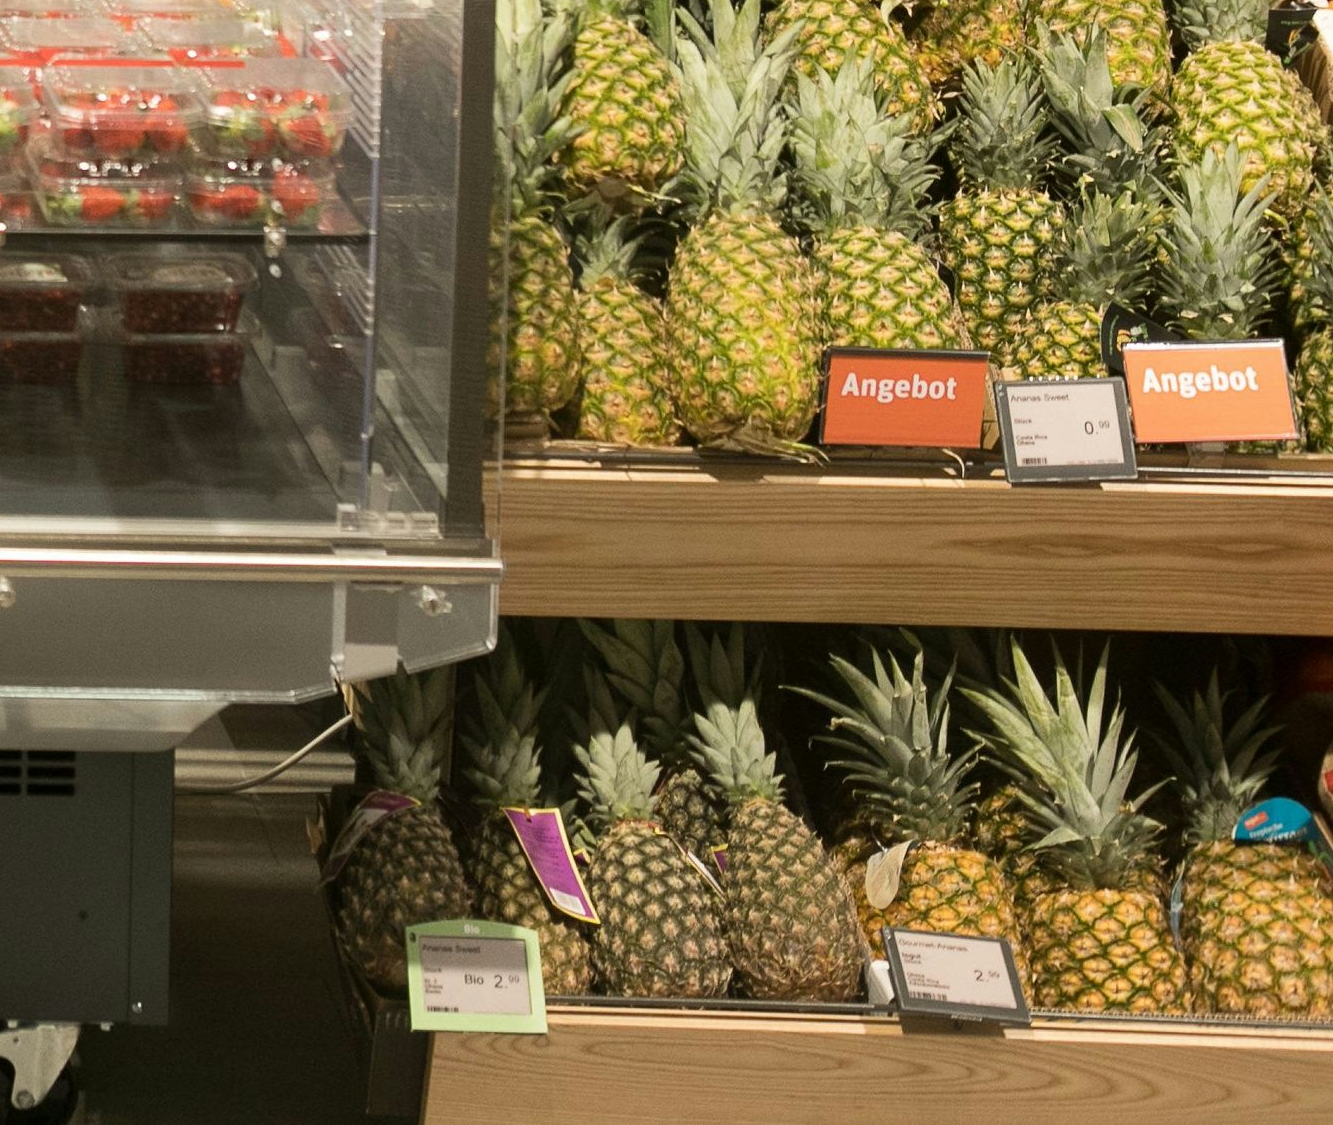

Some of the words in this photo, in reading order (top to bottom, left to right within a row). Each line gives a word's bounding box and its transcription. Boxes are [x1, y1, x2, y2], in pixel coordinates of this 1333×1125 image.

[1142, 364, 1259, 399] Angebot
[841, 372, 958, 404] Angebot
[1010, 393, 1042, 403] Ananas
[1044, 393, 1070, 402] Sweet
[464, 924, 481, 935] Bio
[422, 943, 453, 953] Ananas
[464, 974, 484, 985] Bio
